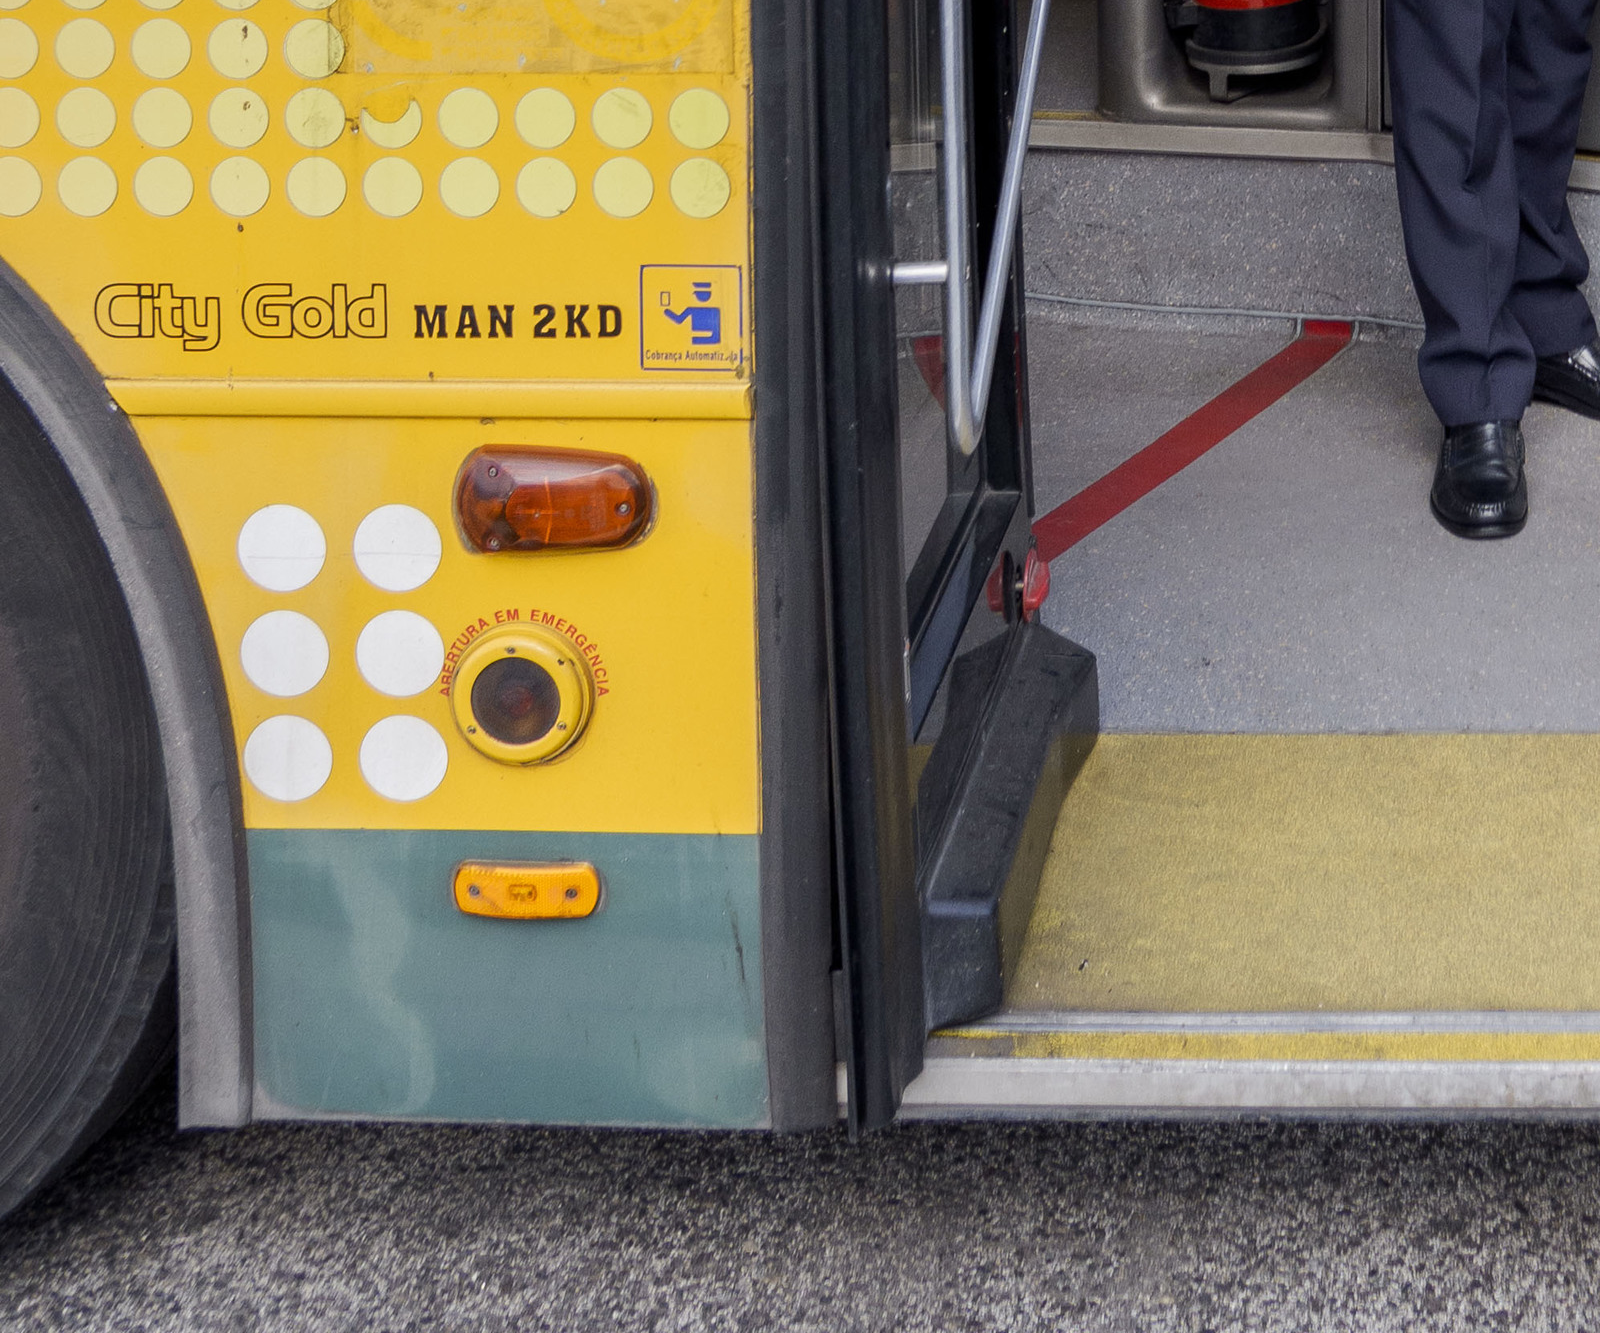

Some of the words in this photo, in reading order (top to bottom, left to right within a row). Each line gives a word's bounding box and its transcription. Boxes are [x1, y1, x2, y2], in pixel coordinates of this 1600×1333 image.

[94, 283, 221, 353] City
[241, 283, 387, 339] Gold
[413, 303, 515, 339] MAN
[532, 303, 623, 339] 2KD
[645, 349, 683, 361] Cobrança
[440, 617, 490, 698] ABERTURA
[494, 608, 520, 624] EM
[529, 609, 610, 697] EMERGÊNCIA
